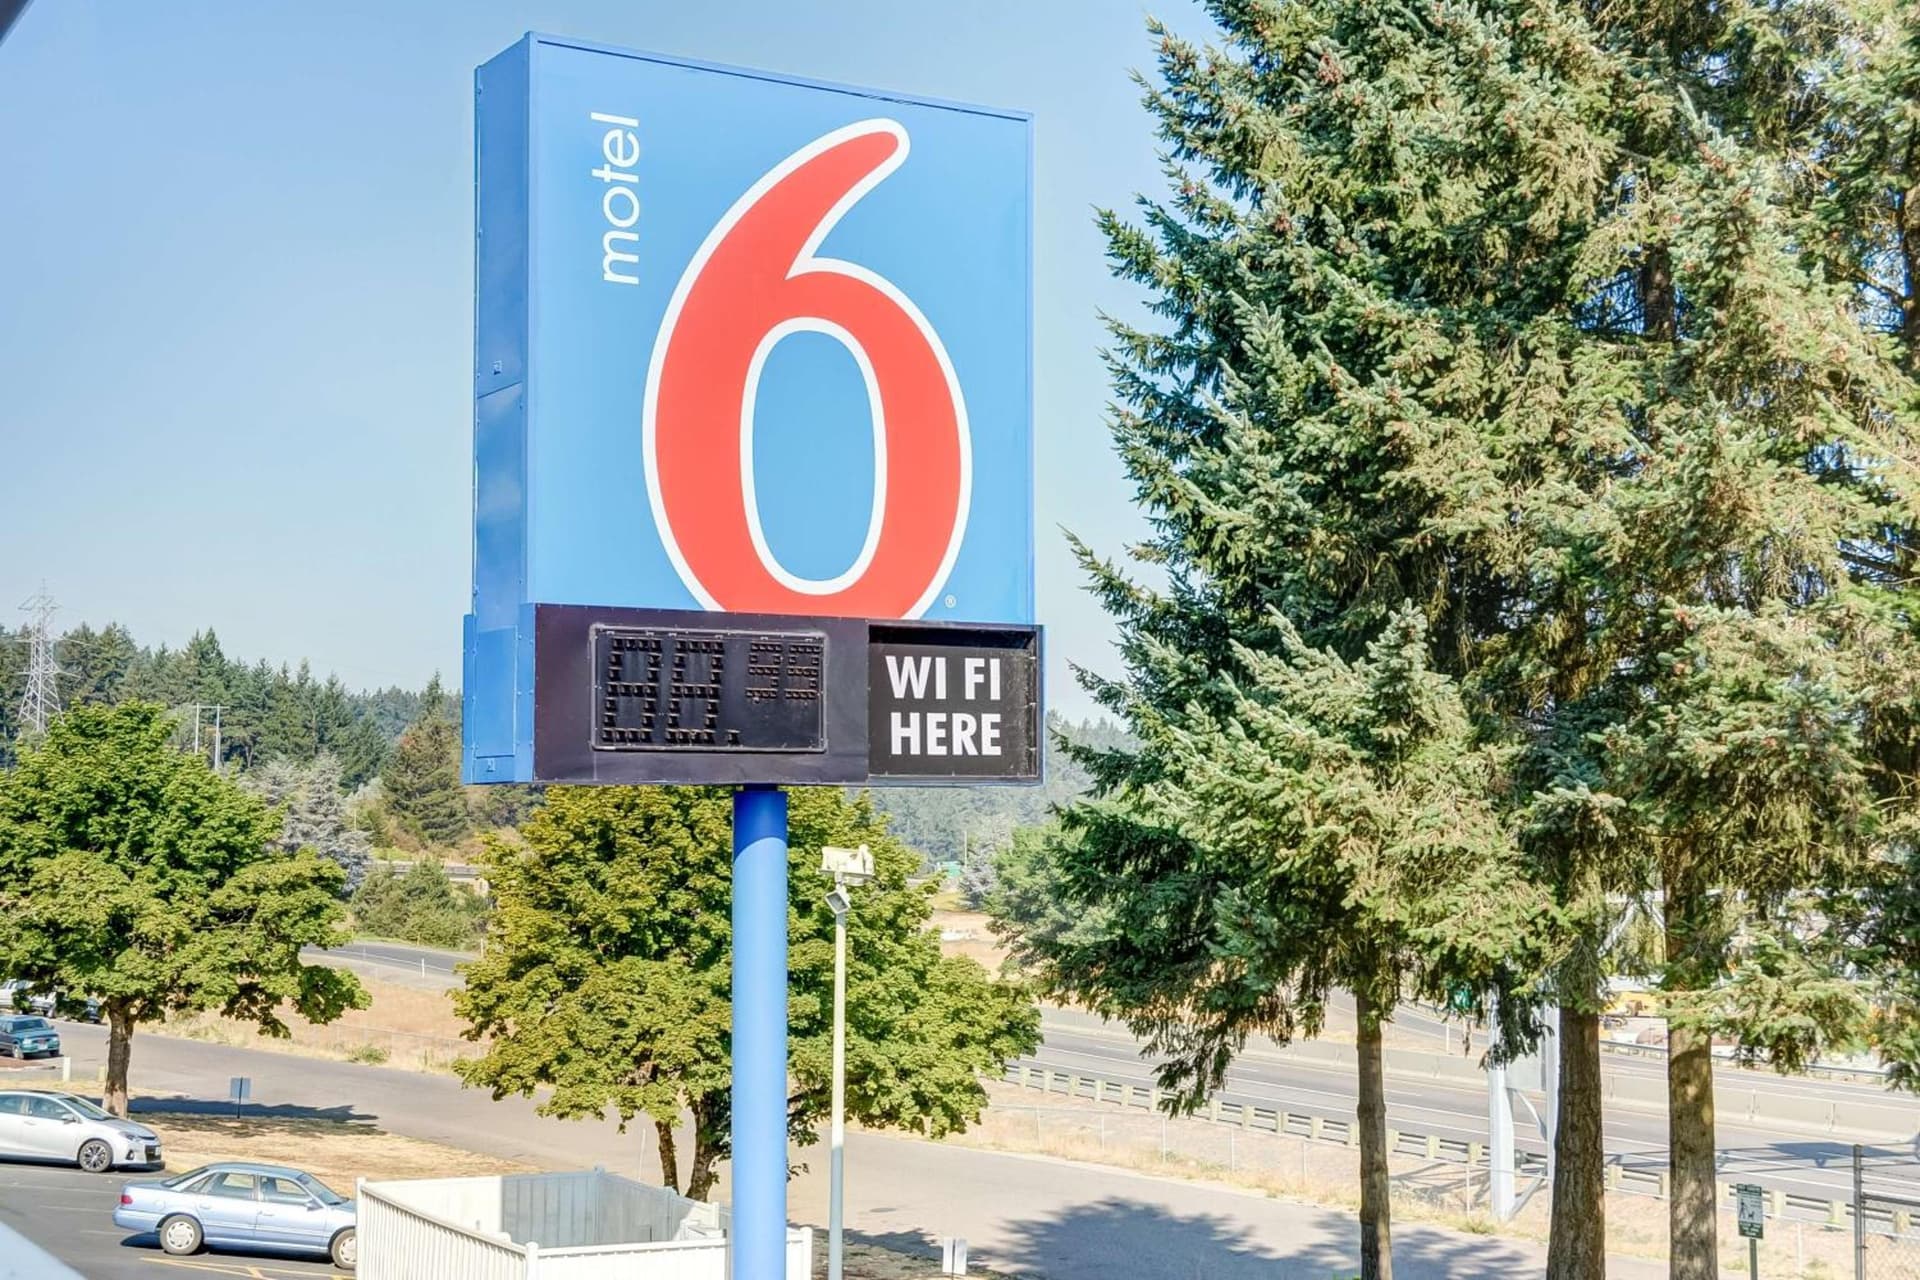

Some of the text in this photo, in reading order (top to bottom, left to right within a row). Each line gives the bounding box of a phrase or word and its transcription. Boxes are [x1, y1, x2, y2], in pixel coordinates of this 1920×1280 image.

[590, 111, 640, 285] motel
[642, 117, 973, 619] 6
[885, 655, 1001, 701] WI FI
[890, 711, 1002, 756] HERE
